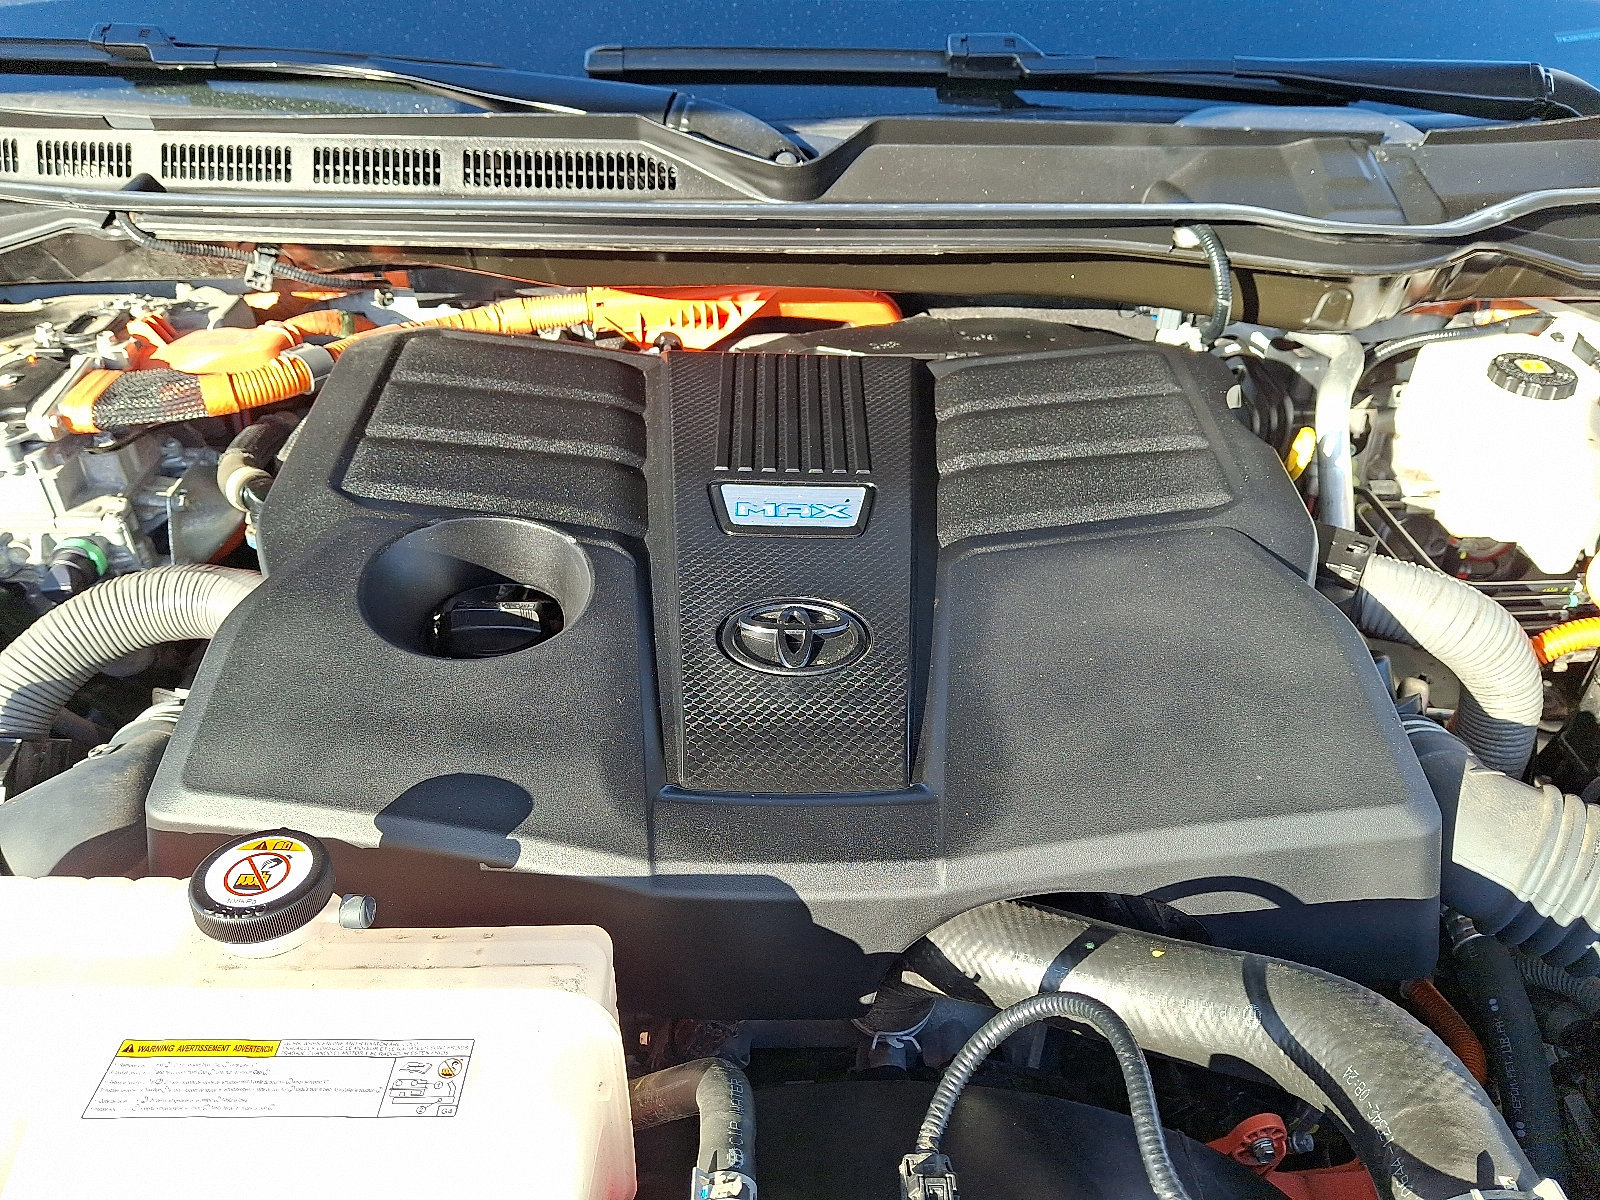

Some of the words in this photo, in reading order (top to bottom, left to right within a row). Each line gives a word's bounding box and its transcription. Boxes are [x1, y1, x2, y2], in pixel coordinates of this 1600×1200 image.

[735, 501, 852, 519] MAX
[137, 1044, 176, 1053] WARNING
[176, 1044, 231, 1053] AVERTISSEMENT
[233, 1044, 274, 1053] ADVERTENCIA
